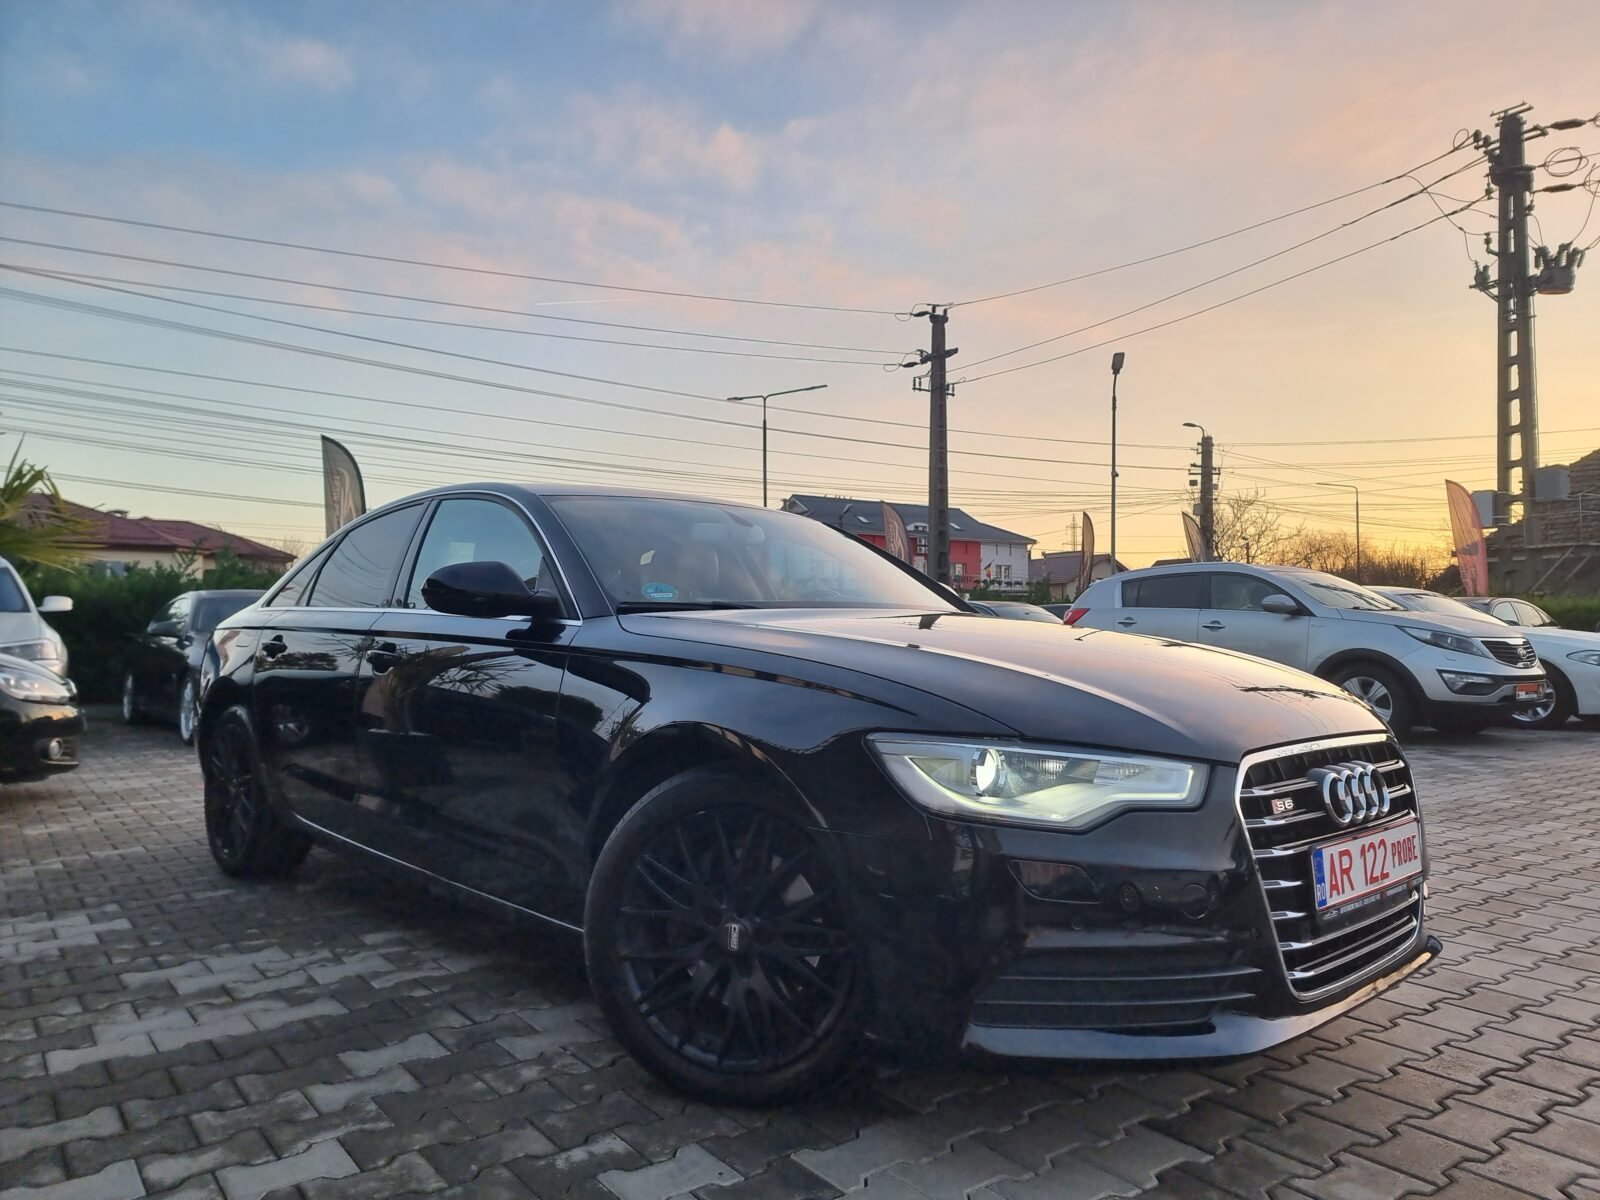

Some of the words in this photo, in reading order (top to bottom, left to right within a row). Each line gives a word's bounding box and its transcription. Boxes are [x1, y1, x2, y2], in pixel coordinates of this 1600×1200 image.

[1275, 799, 1294, 811] S6
[1329, 848, 1355, 898] AR
[1360, 838, 1390, 886] 122
[1391, 835, 1418, 869] PROBE
[1316, 882, 1326, 902] RO
